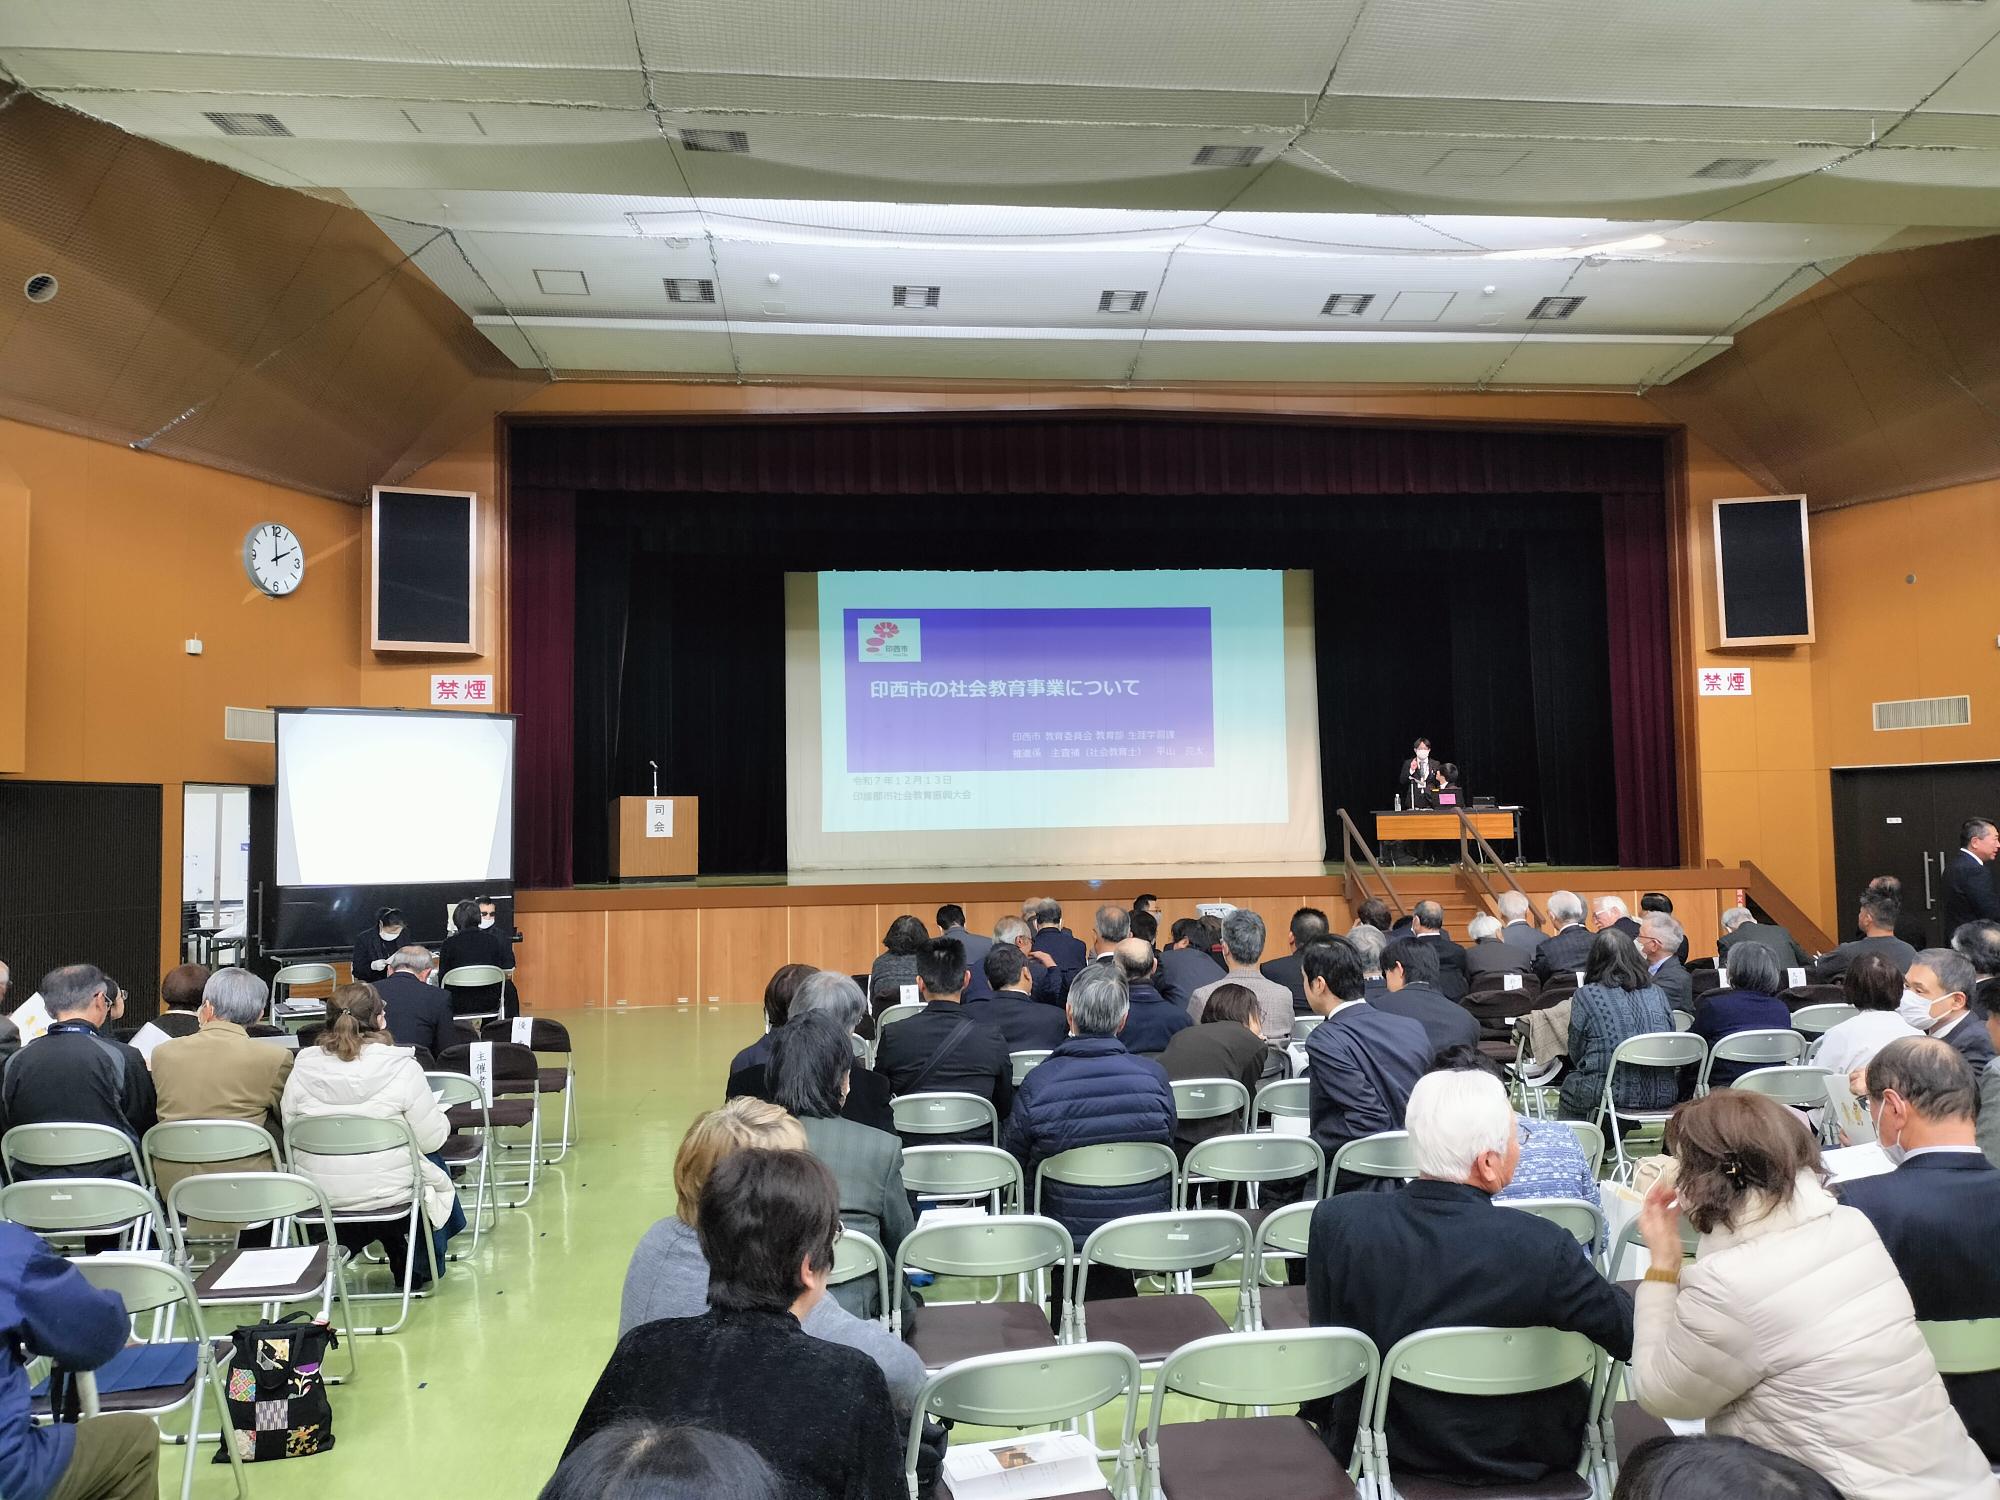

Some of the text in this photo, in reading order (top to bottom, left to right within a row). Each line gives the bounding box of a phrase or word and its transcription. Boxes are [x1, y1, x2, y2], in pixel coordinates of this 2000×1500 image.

[272, 525, 281, 538] 12
[251, 549, 257, 560] 9
[294, 558, 301, 569] 3
[272, 581, 279, 592] 6
[436, 679, 487, 700] 禁煙
[870, 679, 1141, 698] 印西市の社会教育事業について
[1704, 672, 1746, 691] 禁煙
[654, 804, 665, 833] 司会
[474, 1051, 488, 1087] 主催者
